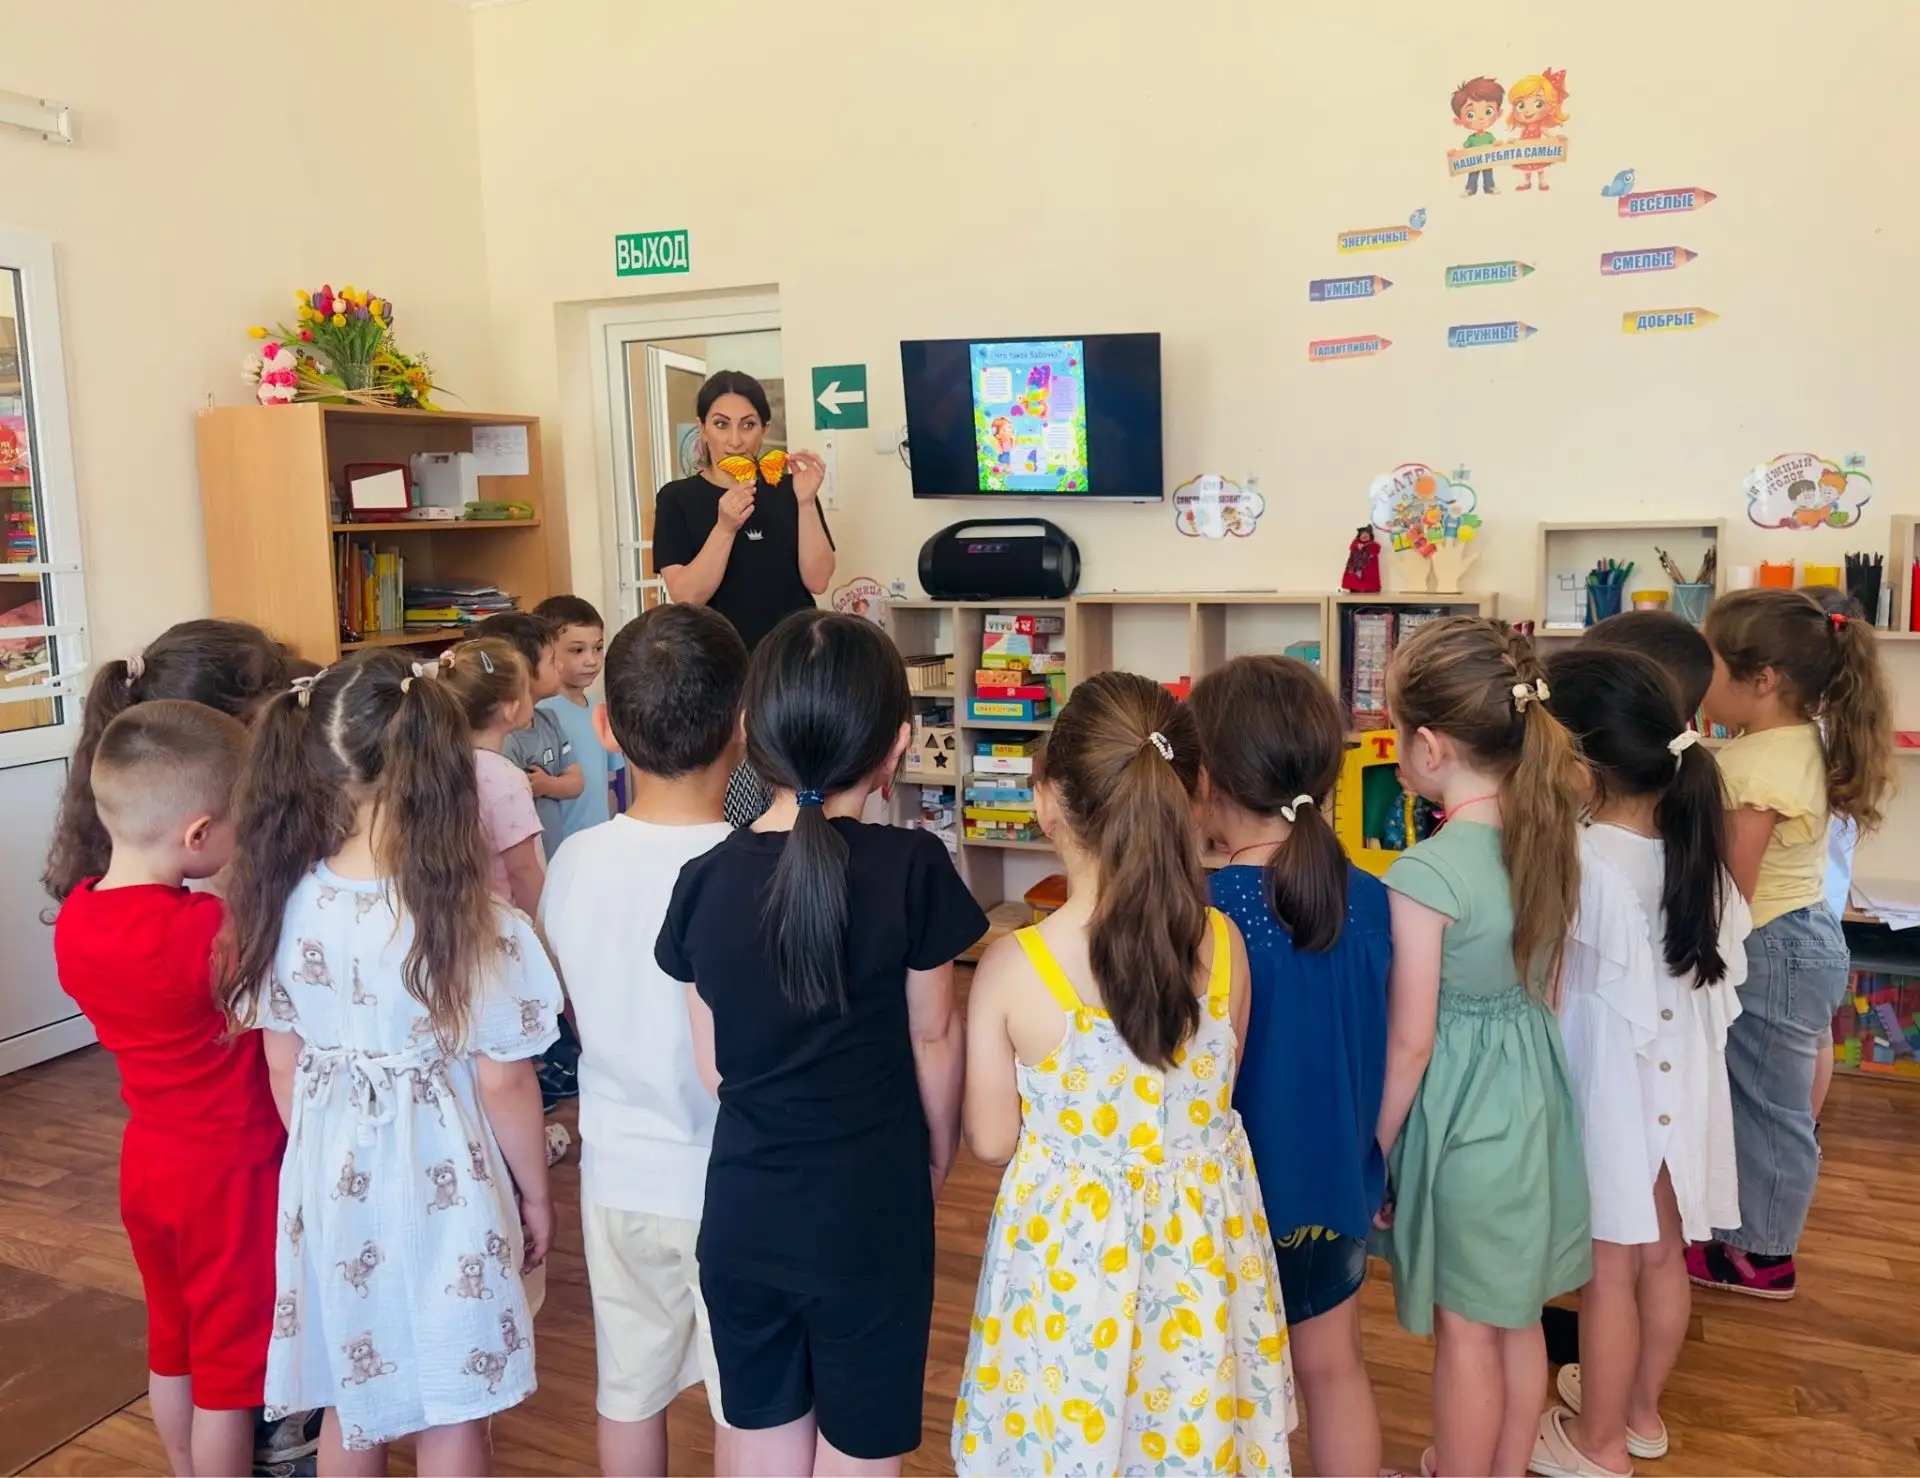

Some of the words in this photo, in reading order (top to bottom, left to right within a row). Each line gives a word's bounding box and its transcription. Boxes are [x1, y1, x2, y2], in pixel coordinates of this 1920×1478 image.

[1453, 154, 1485, 170] НАШИ
[1485, 148, 1523, 163] РЕБЯТА
[1524, 146, 1562, 158] САМЫЕ
[1342, 230, 1408, 248] ЭНЕРГИЧНЫЕ
[617, 235, 687, 269] ВЫХОД
[1612, 251, 1673, 271] СМЕЛЫЕ
[1452, 265, 1518, 282] АКТИВНЫЕ
[1325, 280, 1372, 297] УМНЫЕ
[1637, 312, 1694, 331] ДОБРЫЕ
[1456, 325, 1519, 345] ДРУЖНЫЕ
